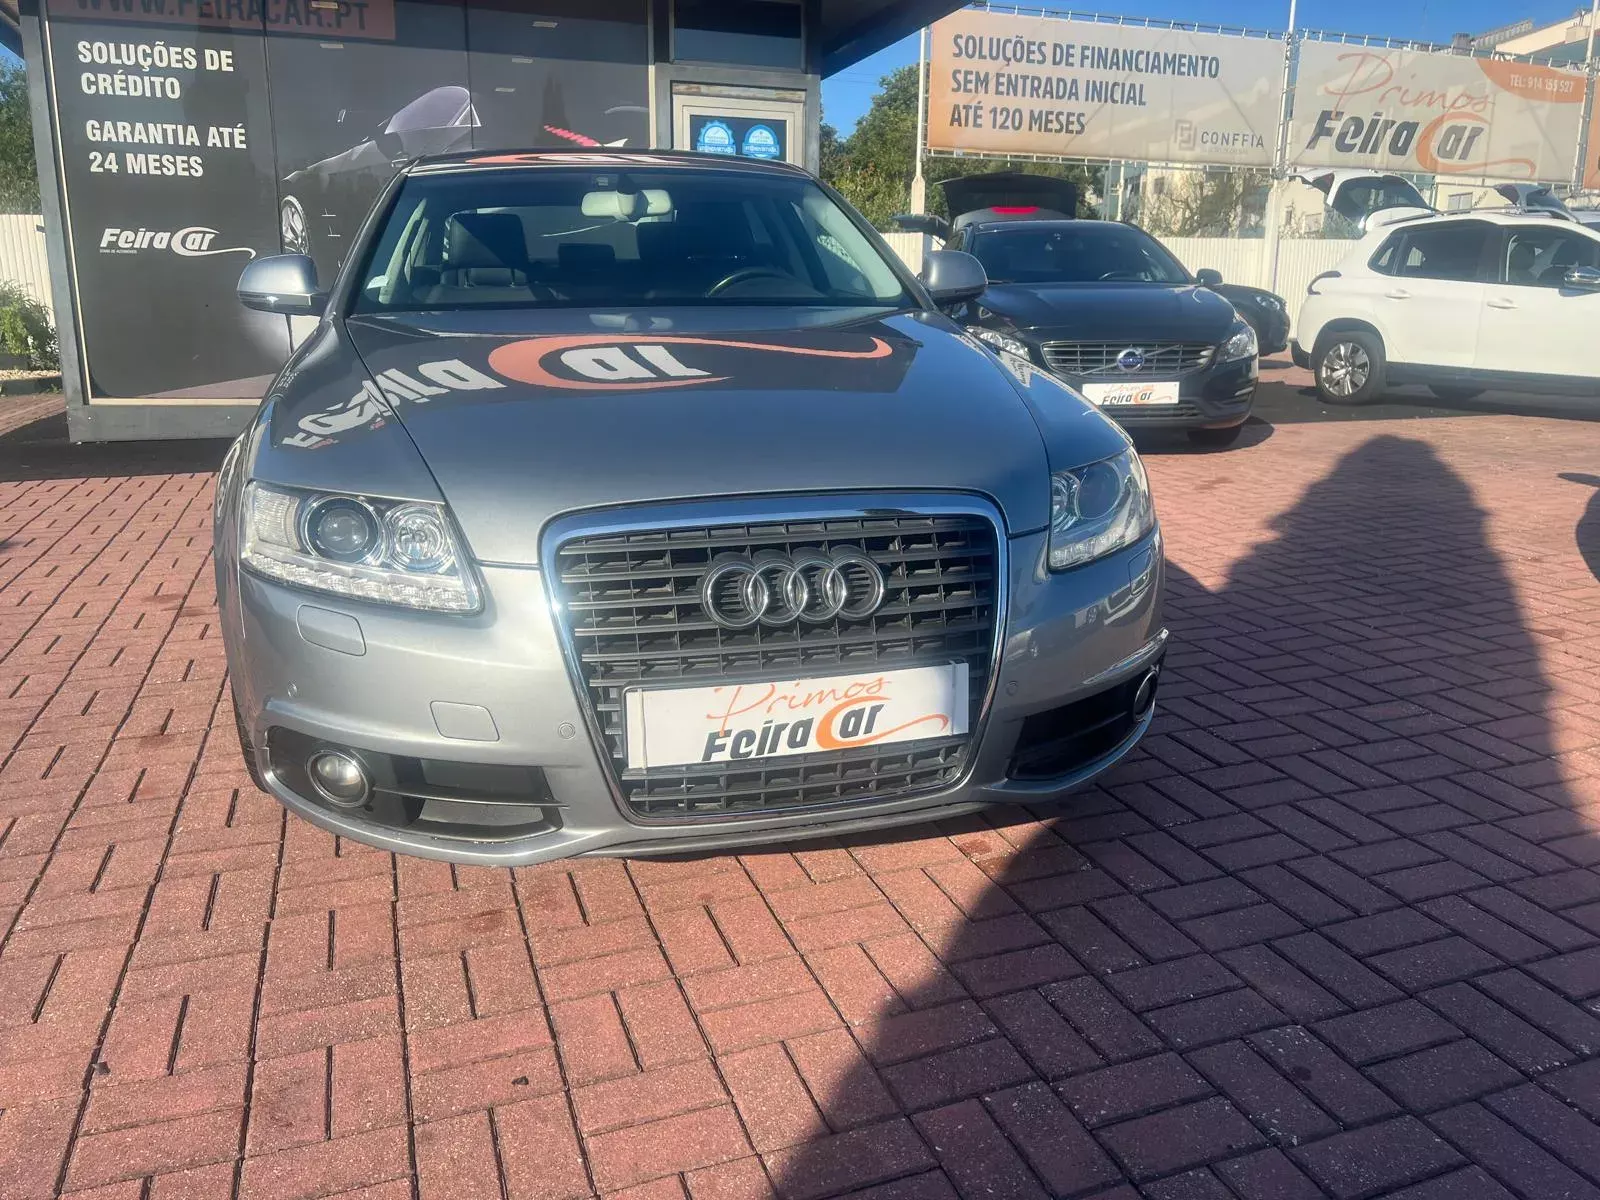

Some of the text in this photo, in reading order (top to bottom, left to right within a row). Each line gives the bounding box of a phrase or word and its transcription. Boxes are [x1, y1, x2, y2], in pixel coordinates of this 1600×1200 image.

[77, 41, 234, 72] SOLUÇÕES DE
[952, 34, 1220, 79] SOLUÇÕES DE FINANCIAMENTO
[81, 70, 181, 99] CRÉDITO
[952, 69, 1147, 106] SEM ENTRADA INICIAL
[1325, 52, 1496, 120] Primos
[86, 119, 247, 149] GARANTIA ATÉ
[950, 101, 1086, 135] ATÉ 120 MESES
[1201, 131, 1264, 148] CONFFIA
[1306, 110, 1536, 177] FeiraCar
[90, 152, 204, 177] 24 MESES
[100, 226, 257, 259] FeiraCar
[706, 676, 892, 737] Primos
[701, 695, 949, 762] FeiraCar
